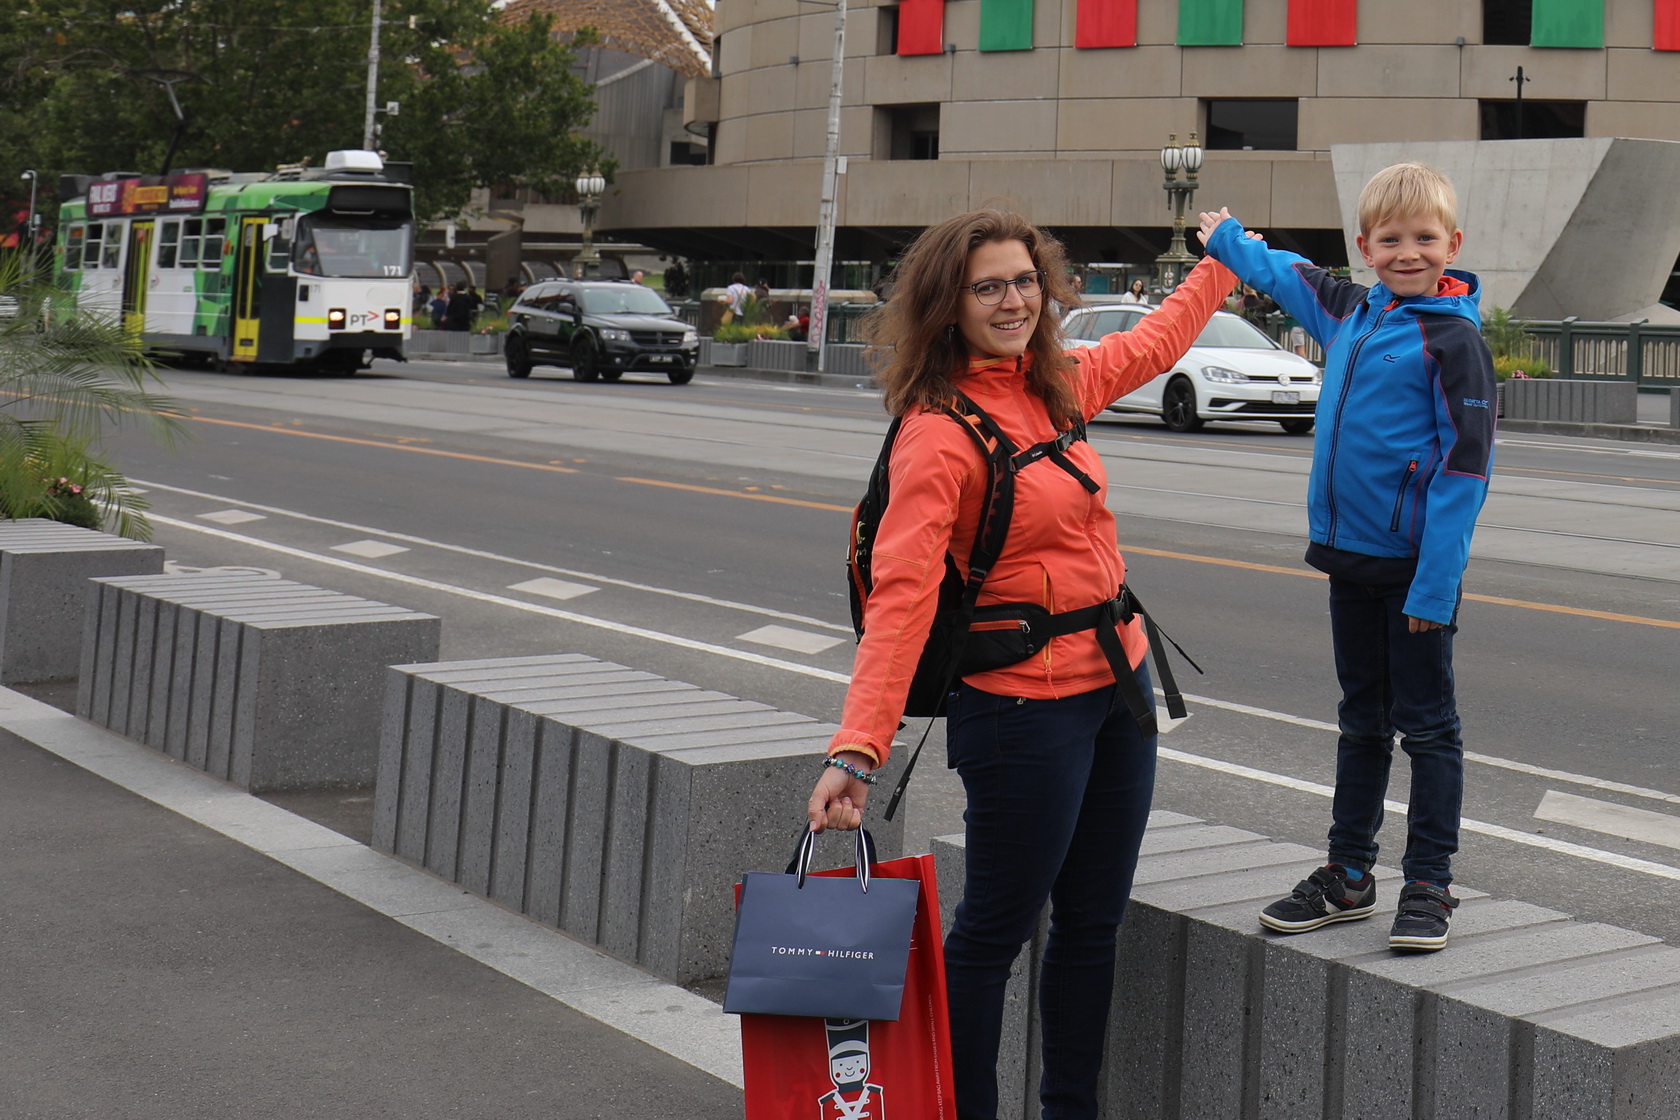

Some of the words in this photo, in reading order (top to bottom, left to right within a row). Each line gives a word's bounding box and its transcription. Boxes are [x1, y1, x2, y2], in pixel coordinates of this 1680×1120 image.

[383, 265, 402, 276] 171
[771, 946, 813, 956] TOMMY
[827, 949, 874, 960] HILFIGER
